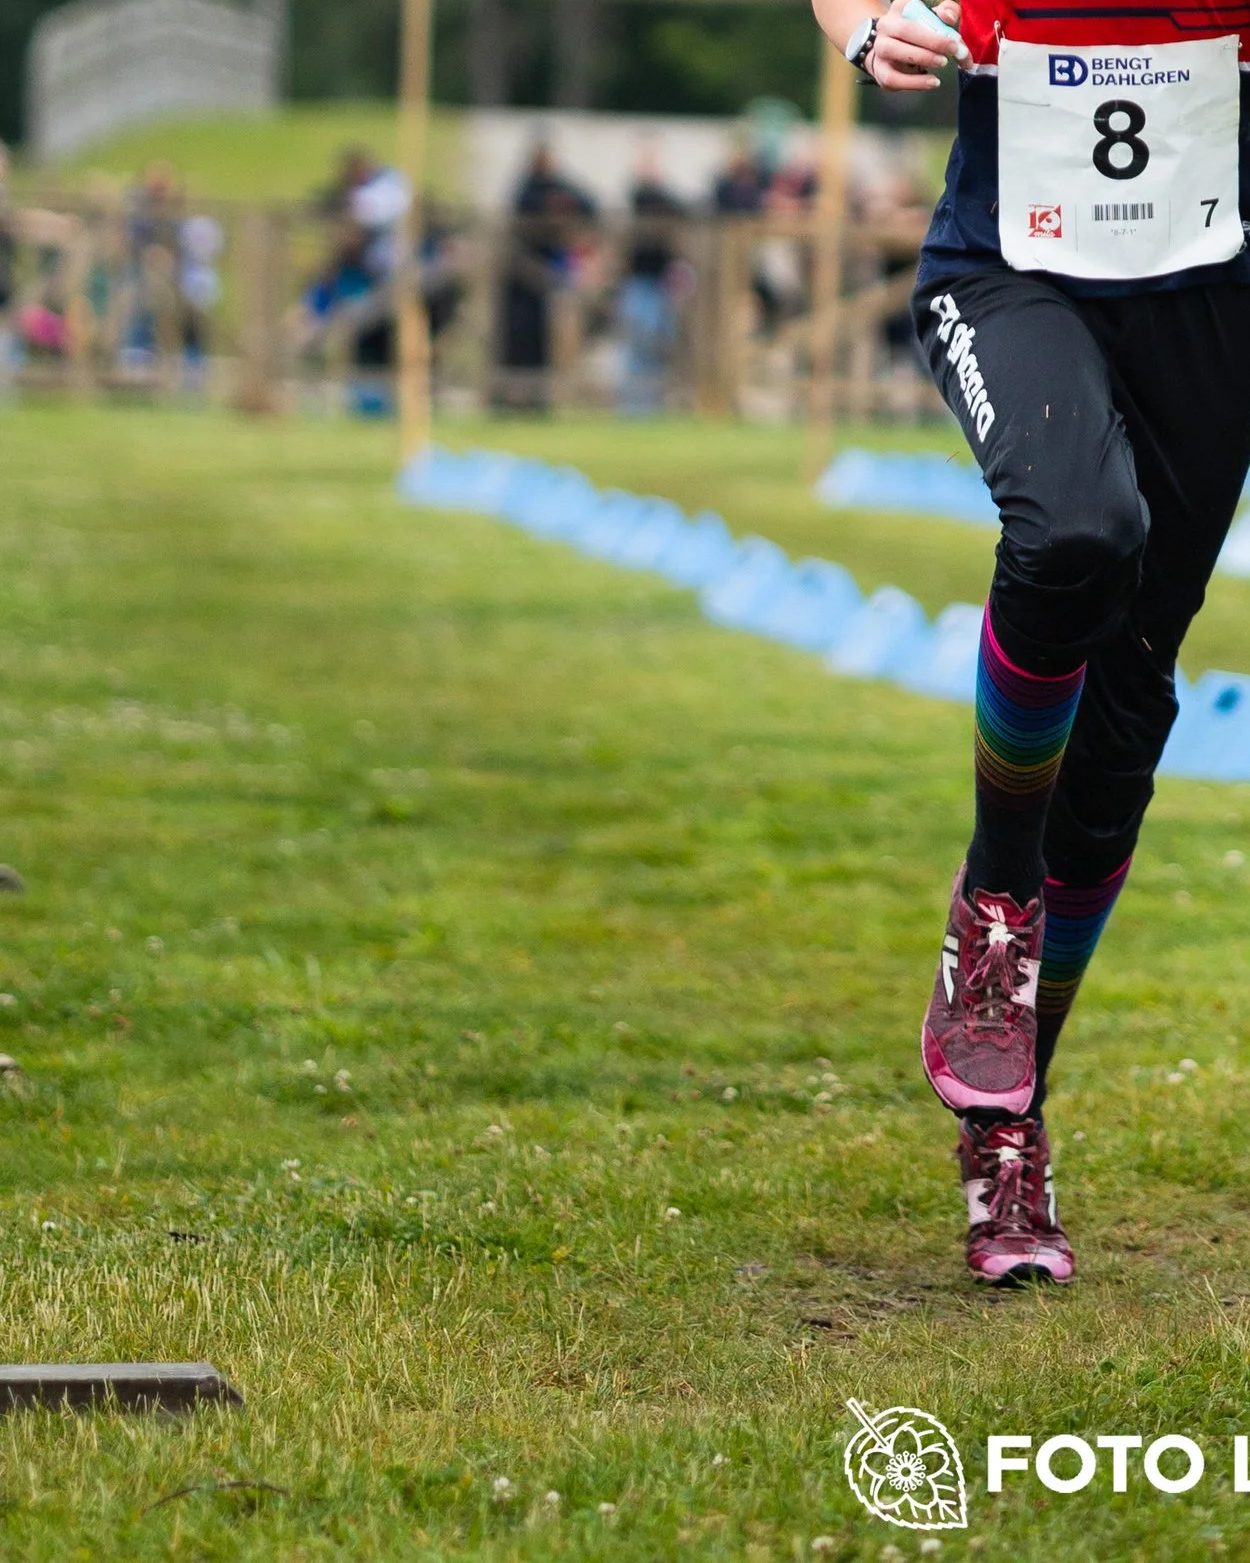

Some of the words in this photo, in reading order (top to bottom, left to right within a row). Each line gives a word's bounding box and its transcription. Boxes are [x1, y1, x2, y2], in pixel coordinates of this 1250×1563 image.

[1092, 57, 1152, 70] BENGT
[1092, 69, 1190, 86] DAHLGREN
[1092, 99, 1150, 180] 8
[1200, 198, 1219, 228] 7
